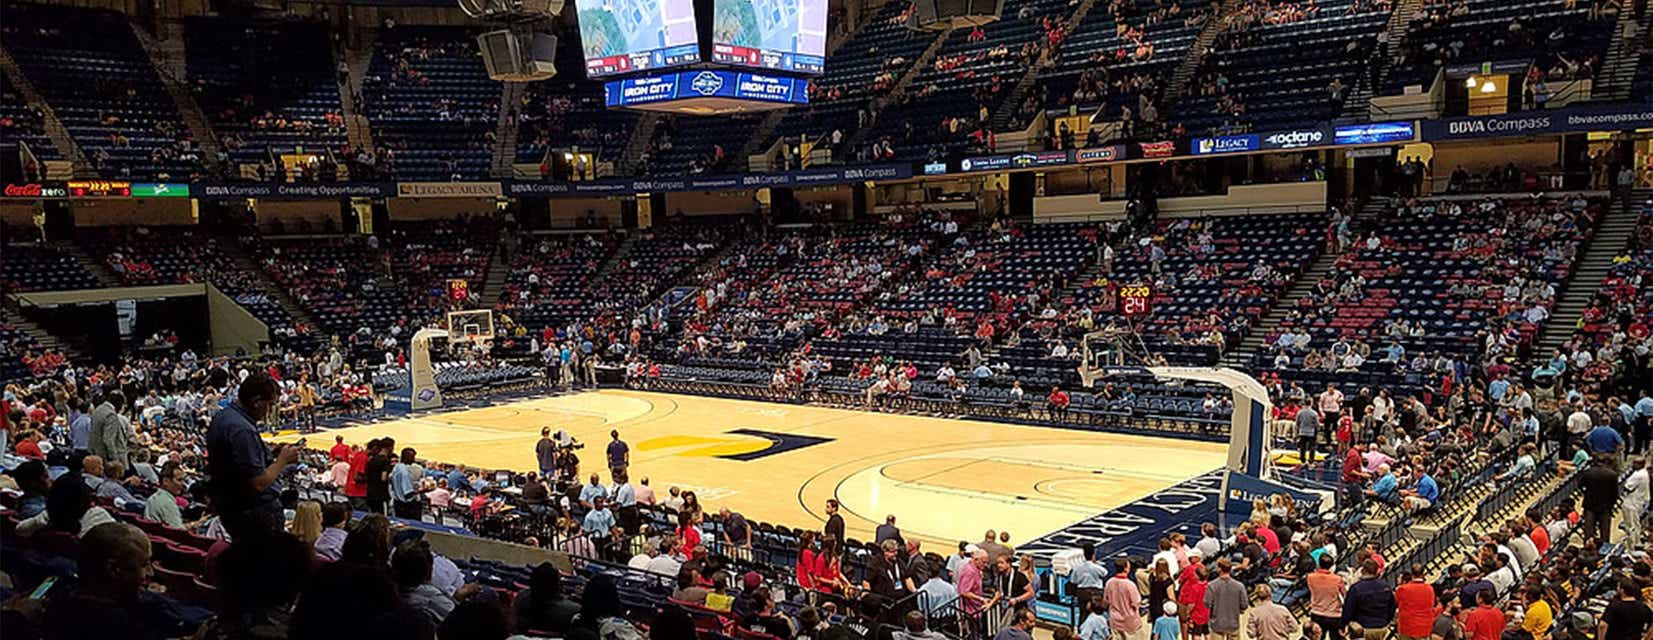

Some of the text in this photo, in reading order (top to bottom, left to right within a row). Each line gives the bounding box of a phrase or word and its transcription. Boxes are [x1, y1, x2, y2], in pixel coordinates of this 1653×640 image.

[624, 83, 674, 97] IRON CITY
[740, 82, 789, 95] IRON CITY
[1449, 116, 1551, 134] BBVA Compass
[1277, 130, 1322, 144] octane
[1215, 138, 1249, 149] LEGACY
[844, 168, 897, 178] BBVA Compass
[760, 175, 789, 185] Compass
[457, 185, 495, 194] ARENA
[532, 184, 568, 193] Compass
[652, 181, 685, 190] Compass
[41, 188, 66, 197] zero
[230, 187, 271, 196] Compass
[278, 186, 381, 196] Creating Opportunities
[1124, 297, 1145, 314] 24
